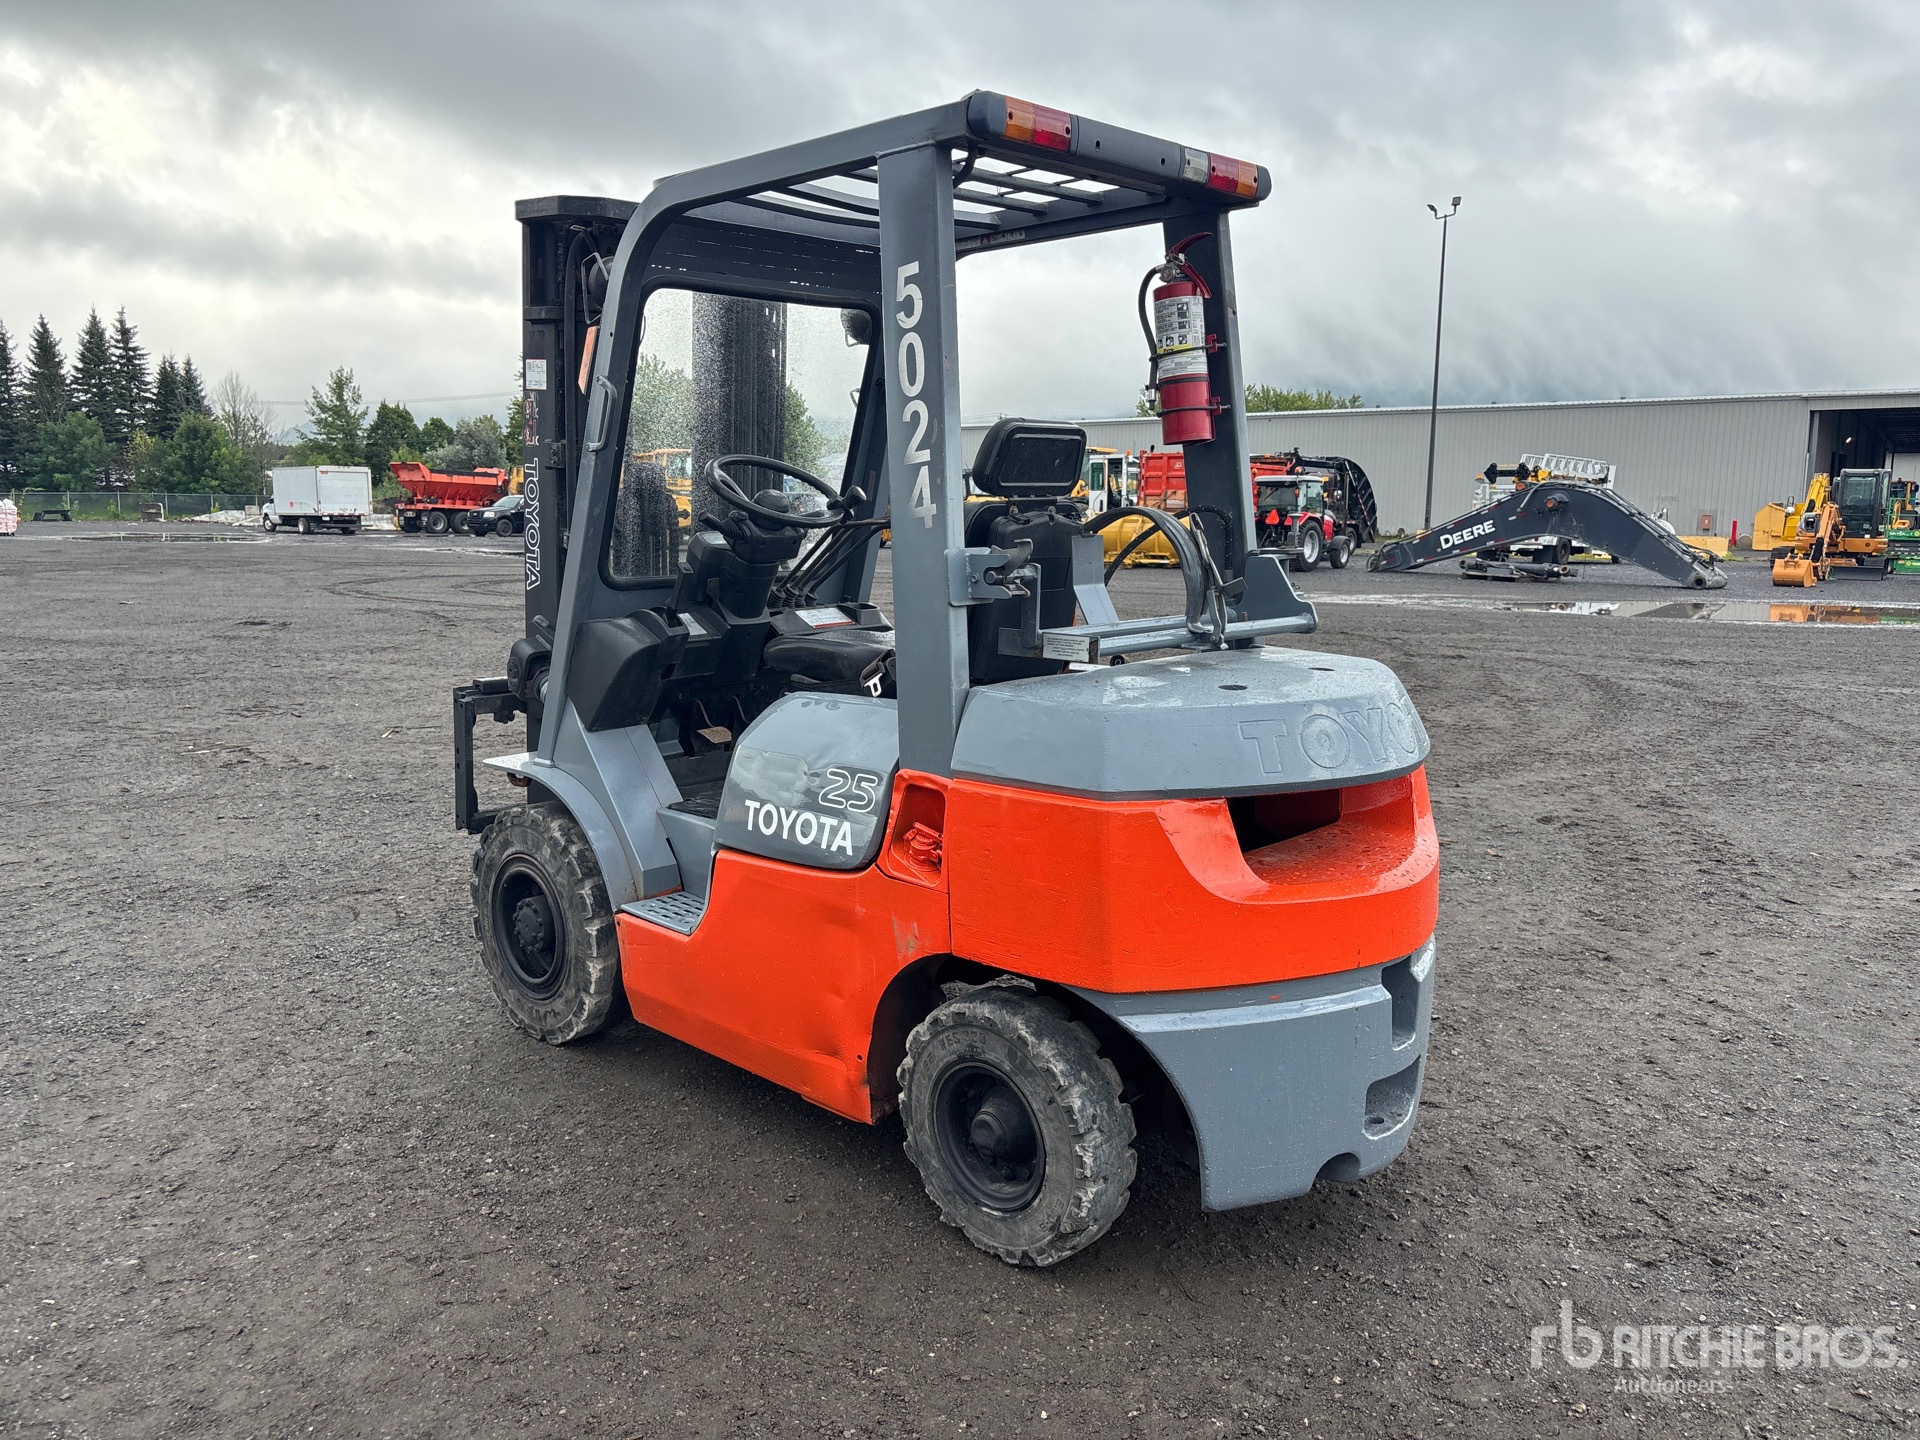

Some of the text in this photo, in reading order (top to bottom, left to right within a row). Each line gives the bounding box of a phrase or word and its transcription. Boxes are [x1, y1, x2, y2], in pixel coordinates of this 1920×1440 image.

[895, 260, 937, 529] 5024
[524, 457, 541, 591] TOYOTA
[1439, 519, 1496, 550] DEERE
[818, 767, 879, 813] 25
[744, 799, 853, 856] TOYOTA
